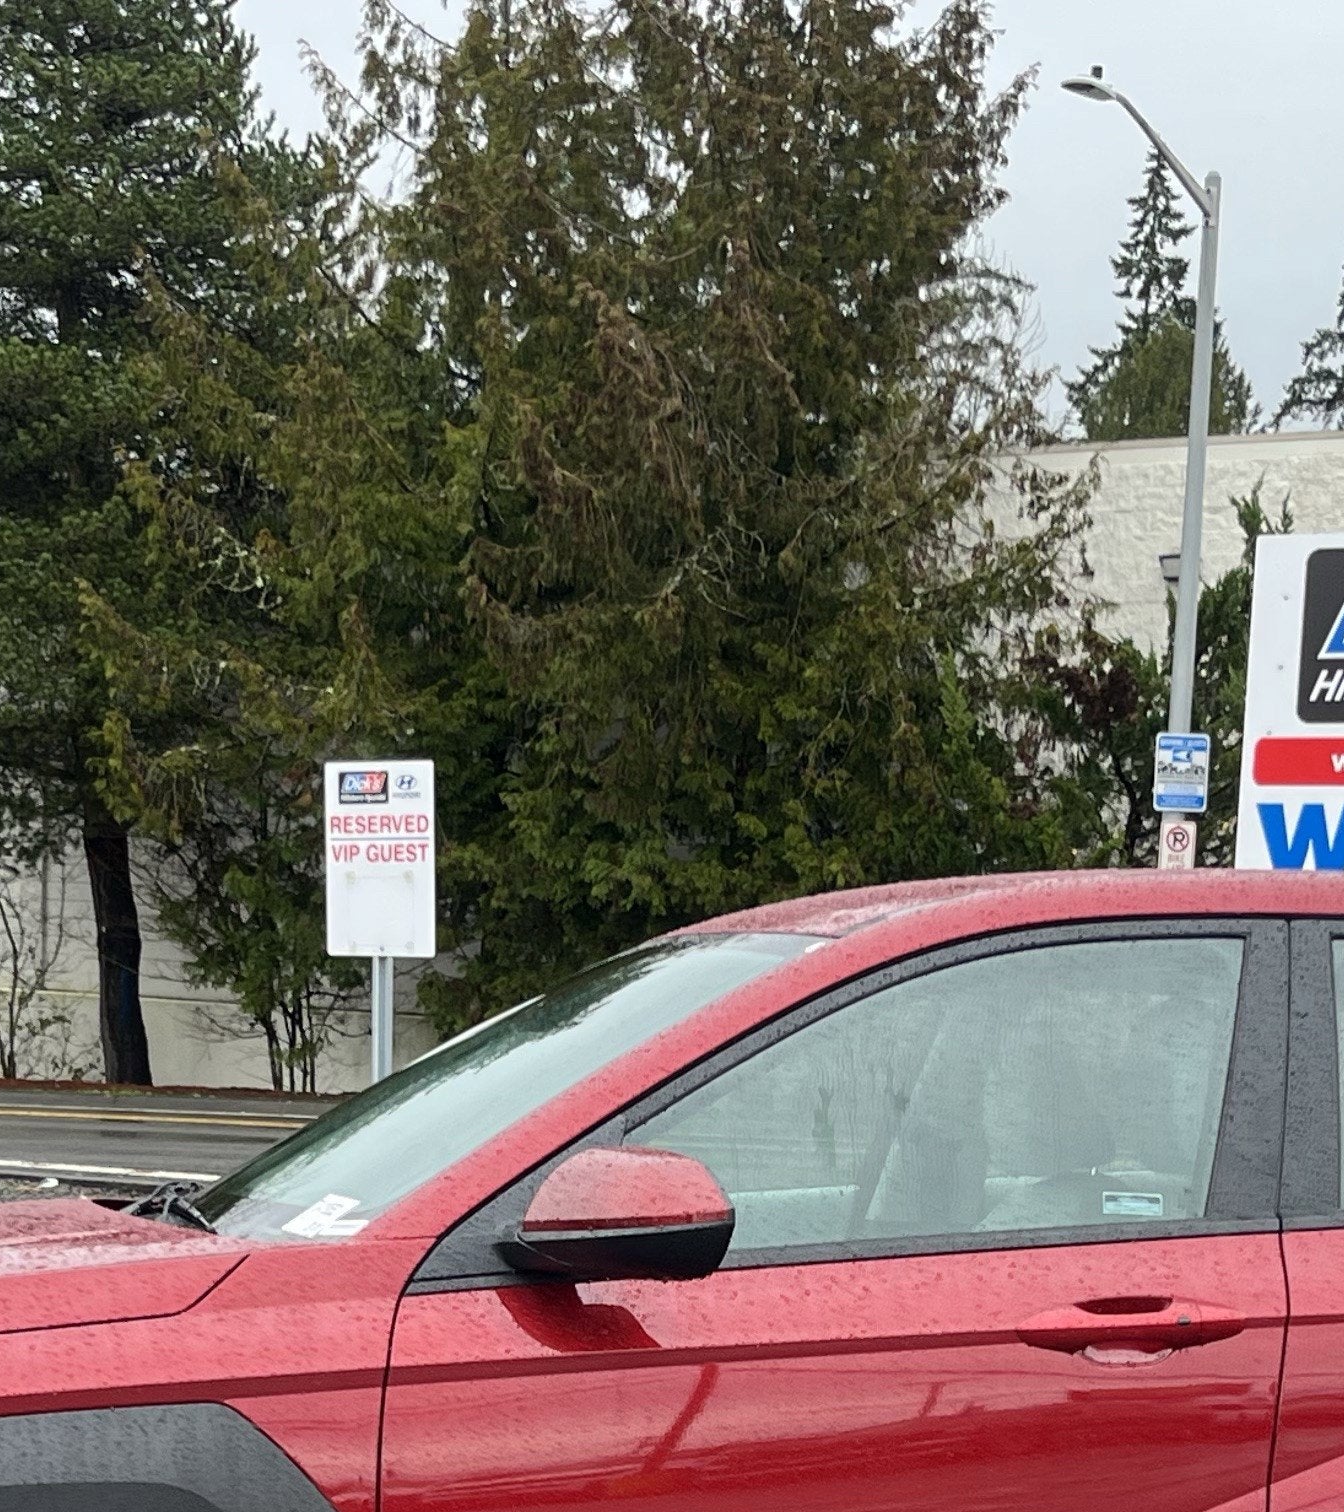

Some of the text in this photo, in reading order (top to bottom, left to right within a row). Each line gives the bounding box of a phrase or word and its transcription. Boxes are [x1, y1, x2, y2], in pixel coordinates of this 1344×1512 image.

[330, 814, 430, 834] RESERVED
[331, 843, 430, 863] VIP GUEST
